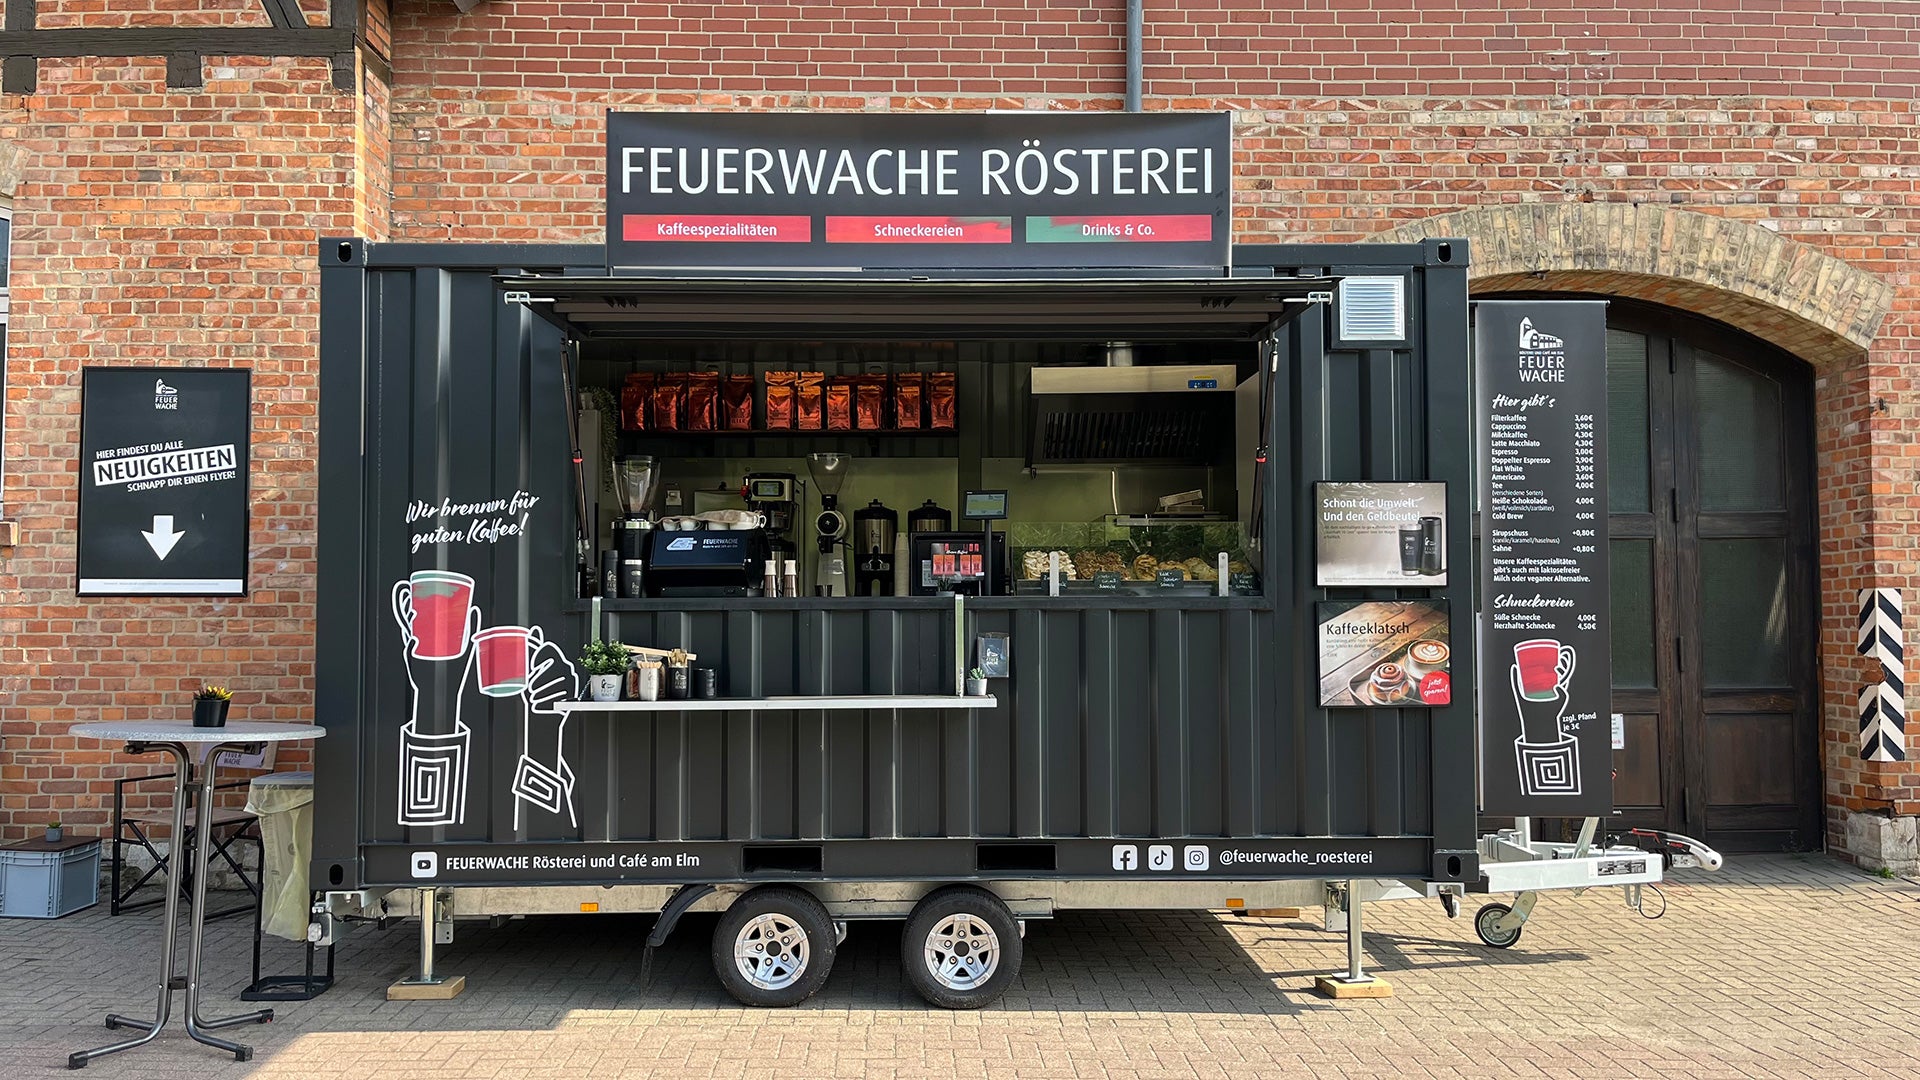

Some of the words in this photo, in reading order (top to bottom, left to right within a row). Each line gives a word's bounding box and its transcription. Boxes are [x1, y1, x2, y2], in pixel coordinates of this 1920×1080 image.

[622, 147, 959, 196] FEUERWACHE
[983, 138, 1213, 196] RÖSTEREI
[657, 222, 778, 238] Kaffeespezialitäten
[874, 223, 964, 238] Schneckereien
[1082, 223, 1121, 237] Drinks
[1124, 223, 1134, 237] &
[1137, 223, 1156, 237] Co.
[1519, 356, 1564, 368] FEUER
[1519, 369, 1564, 382] WACHE
[1492, 394, 1520, 409] Hier
[96, 450, 115, 459] HIER
[117, 444, 149, 456] FINDEST
[150, 443, 163, 452] DU
[164, 441, 184, 450] ALLE
[98, 448, 233, 482] NEUIGKEITEN
[127, 479, 166, 492] SCHNAPP
[168, 478, 182, 486] DIR
[184, 474, 208, 484] EINEN
[210, 471, 236, 481] FLYER!
[406, 500, 439, 523] Wir
[509, 490, 540, 515] für
[1323, 498, 1356, 508] Schont
[1359, 498, 1374, 508] die
[1377, 498, 1418, 508] Umwelt.
[1324, 512, 1345, 521] Und
[1347, 512, 1364, 521] den
[411, 526, 465, 554] guten
[466, 512, 529, 544] Kaffee!
[1516, 558, 1576, 566] Kaffeespezialitäten
[1494, 594, 1575, 608] Schneckereien
[1326, 622, 1409, 635] Kaffeeklatsch
[1562, 714, 1577, 723] zzgl.
[1578, 712, 1596, 721] Pfand
[1564, 723, 1571, 731] je
[446, 856, 529, 870] FEUERWACHE
[533, 855, 586, 868] Rösterei
[590, 854, 615, 868] und
[619, 853, 647, 868] Café
[651, 856, 672, 867] am
[676, 853, 700, 866] Elm
[1219, 849, 1373, 866] @feuerwache_roesterei
